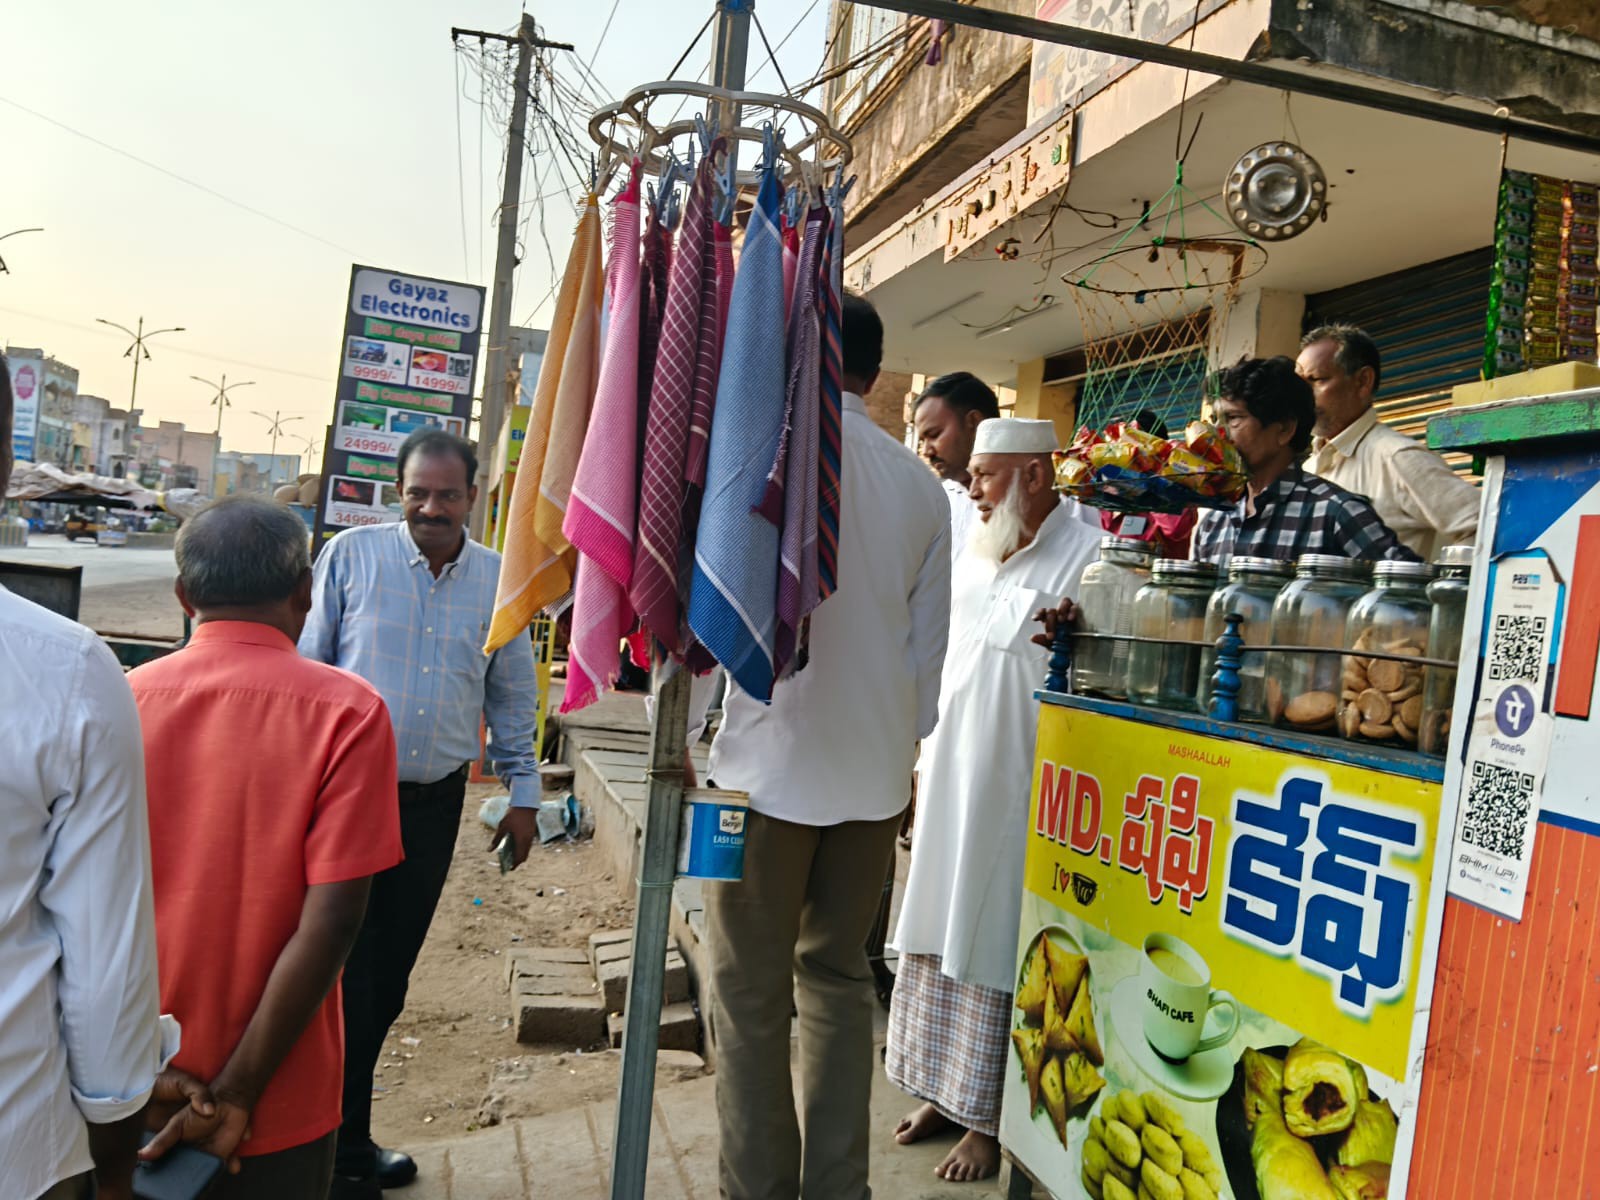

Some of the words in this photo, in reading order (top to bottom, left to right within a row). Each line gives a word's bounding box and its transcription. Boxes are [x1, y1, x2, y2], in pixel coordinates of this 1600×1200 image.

[388, 278, 449, 303] Gayaz
[360, 294, 471, 328] Electronics
[395, 328, 425, 345] days
[353, 365, 397, 381] 9999/-
[414, 375, 465, 392] 14999/-
[359, 386, 379, 401] Big
[344, 436, 396, 454] 24999/-
[1168, 743, 1232, 769] MASHAALLAH
[1490, 738, 1526, 756] PhonePe
[1459, 854, 1489, 871] BHIM
[1147, 989, 1170, 1016] SHAFI
[1171, 1009, 1195, 1023] CAFE
